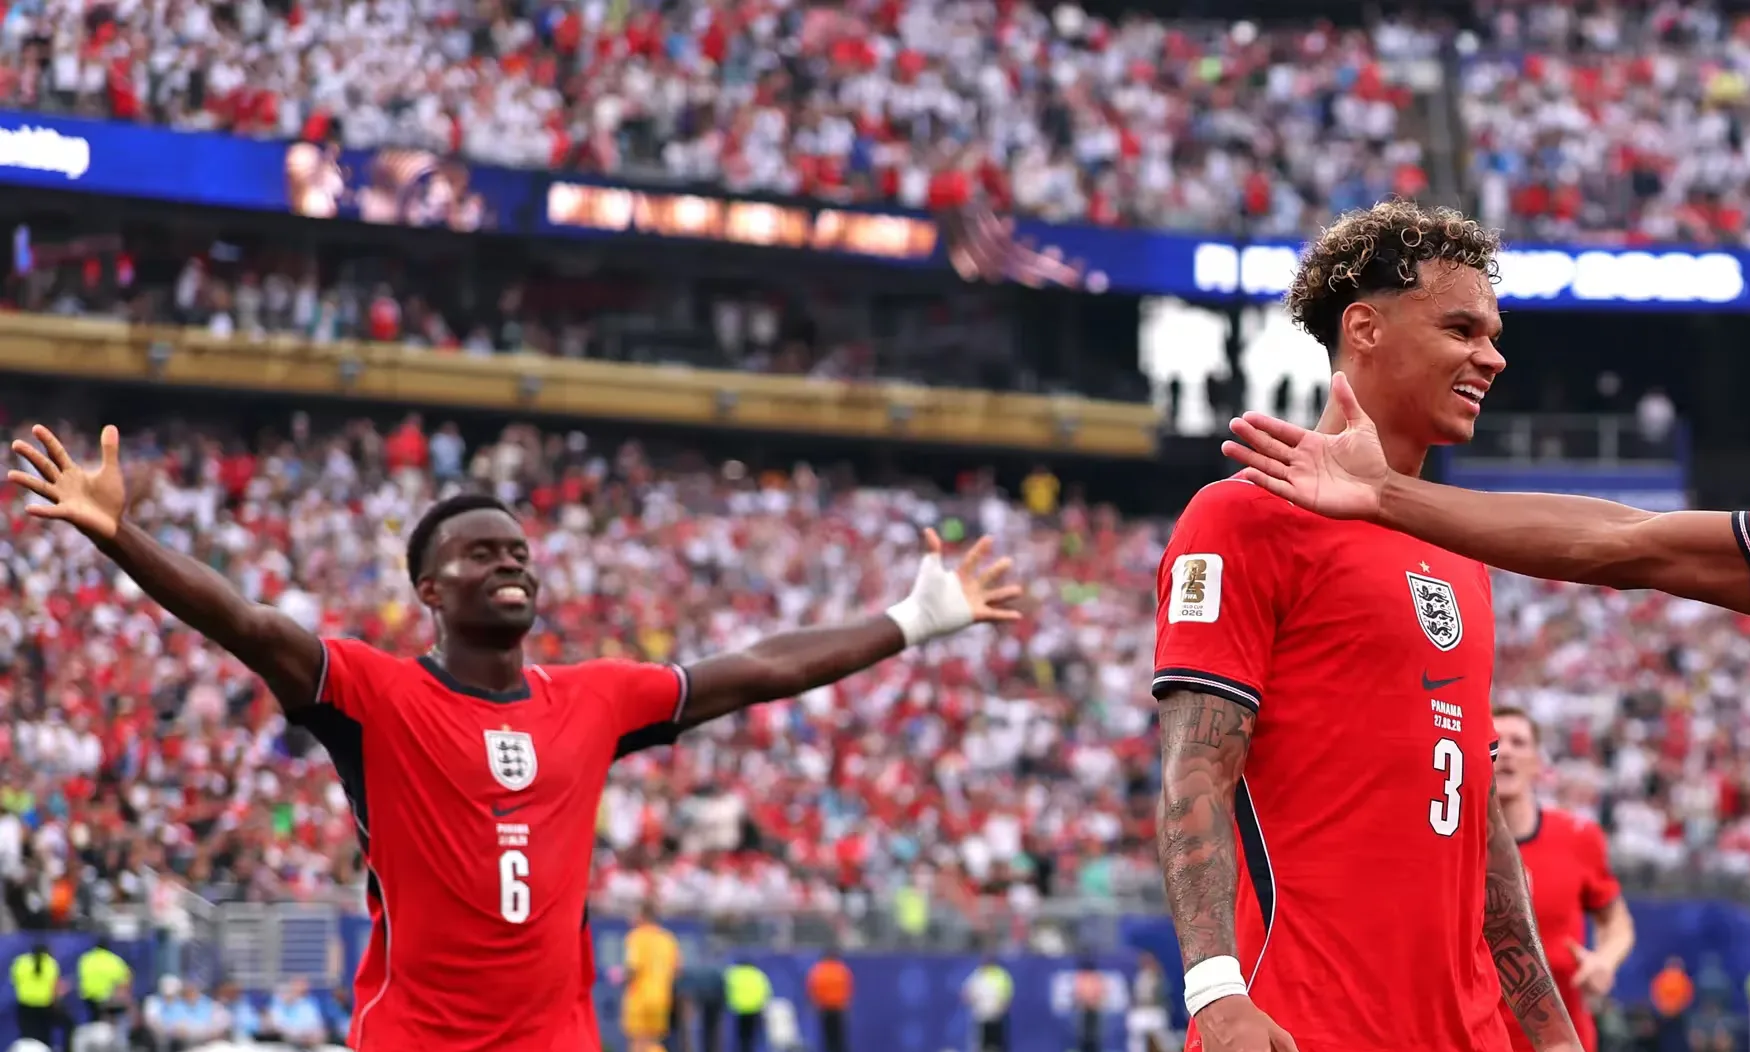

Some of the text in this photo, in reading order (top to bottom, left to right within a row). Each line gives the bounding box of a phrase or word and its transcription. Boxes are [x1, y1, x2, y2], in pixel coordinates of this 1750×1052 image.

[1178, 609, 1203, 617] 026
[1431, 699, 1463, 718] PANAMA
[1429, 737, 1463, 836] 3
[499, 849, 531, 924] 6
